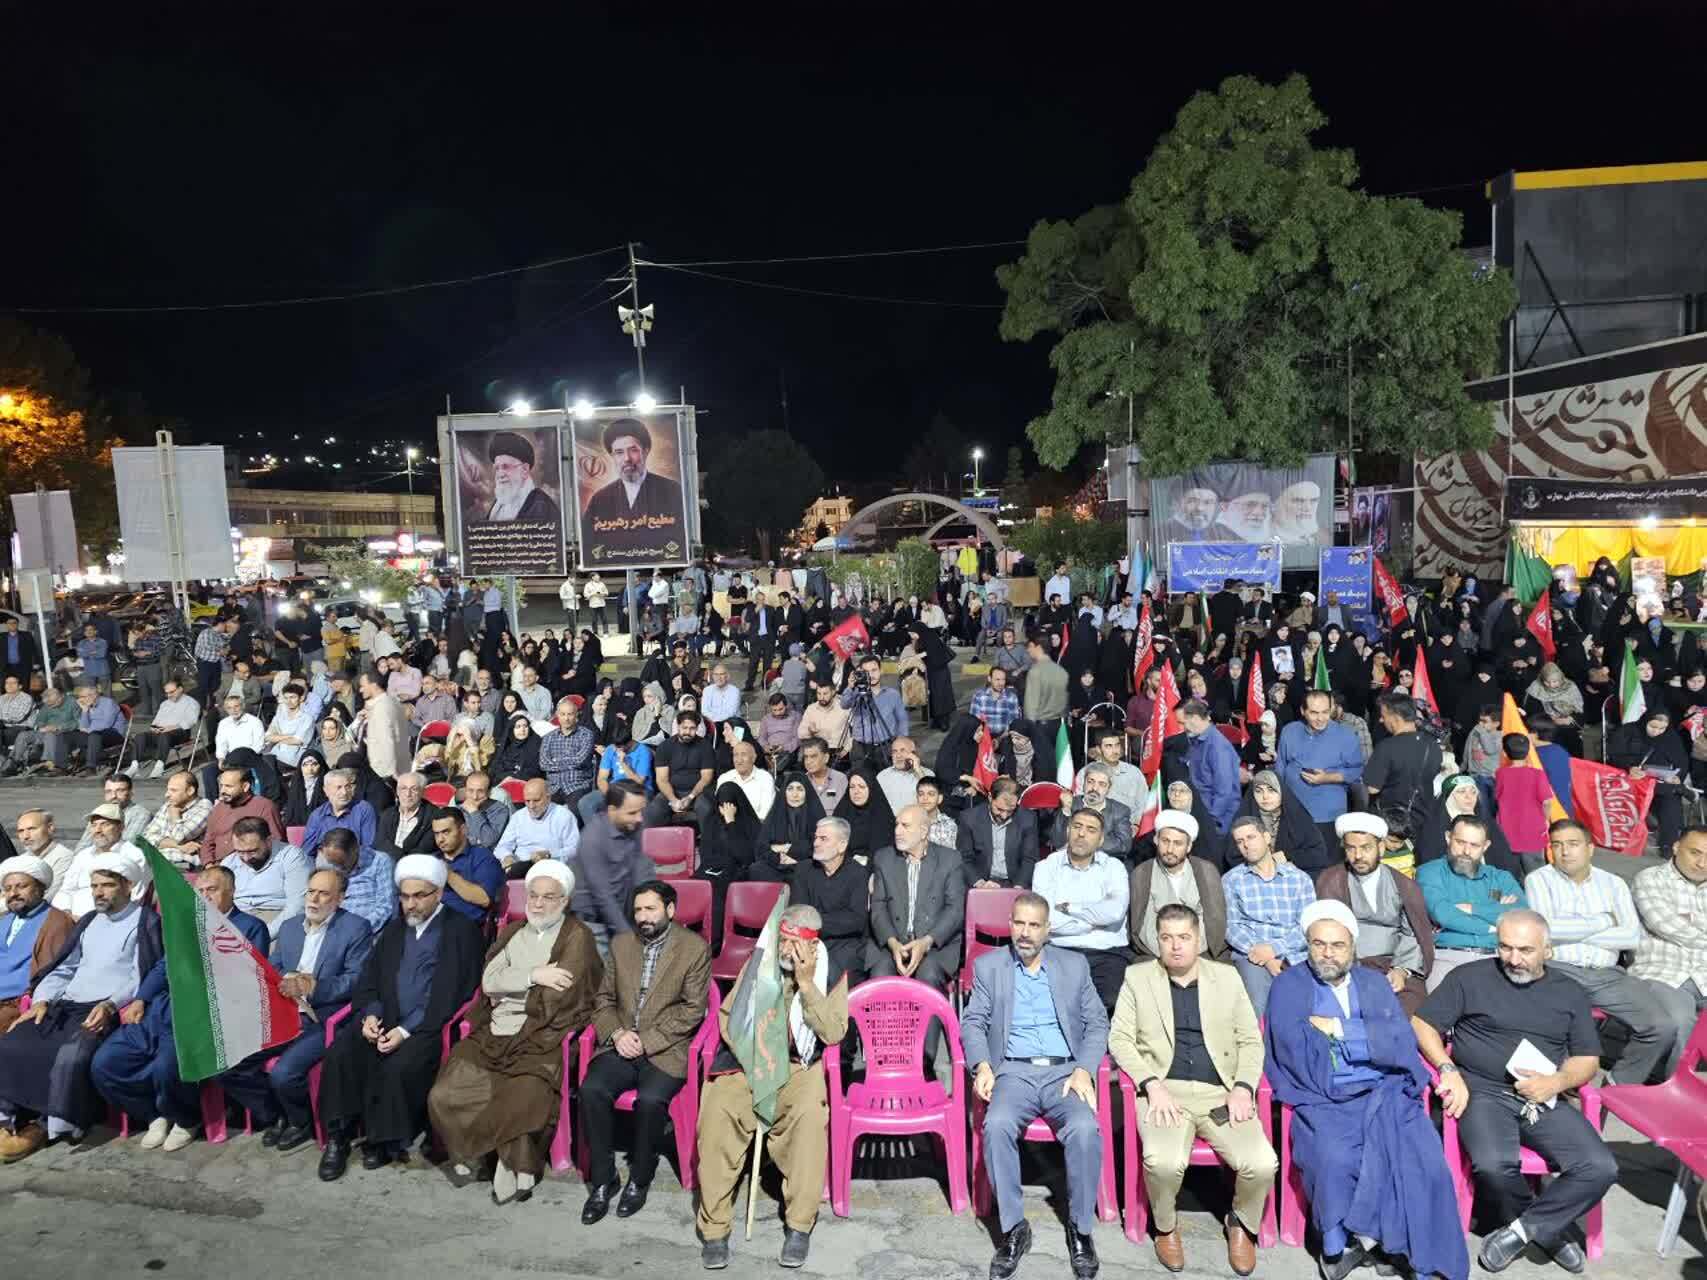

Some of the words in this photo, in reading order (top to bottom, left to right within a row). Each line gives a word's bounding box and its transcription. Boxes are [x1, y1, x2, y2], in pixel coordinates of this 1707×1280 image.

[594, 517, 629, 532] رهبریم
[630, 514, 648, 529] امر
[648, 513, 675, 529] مطیع
